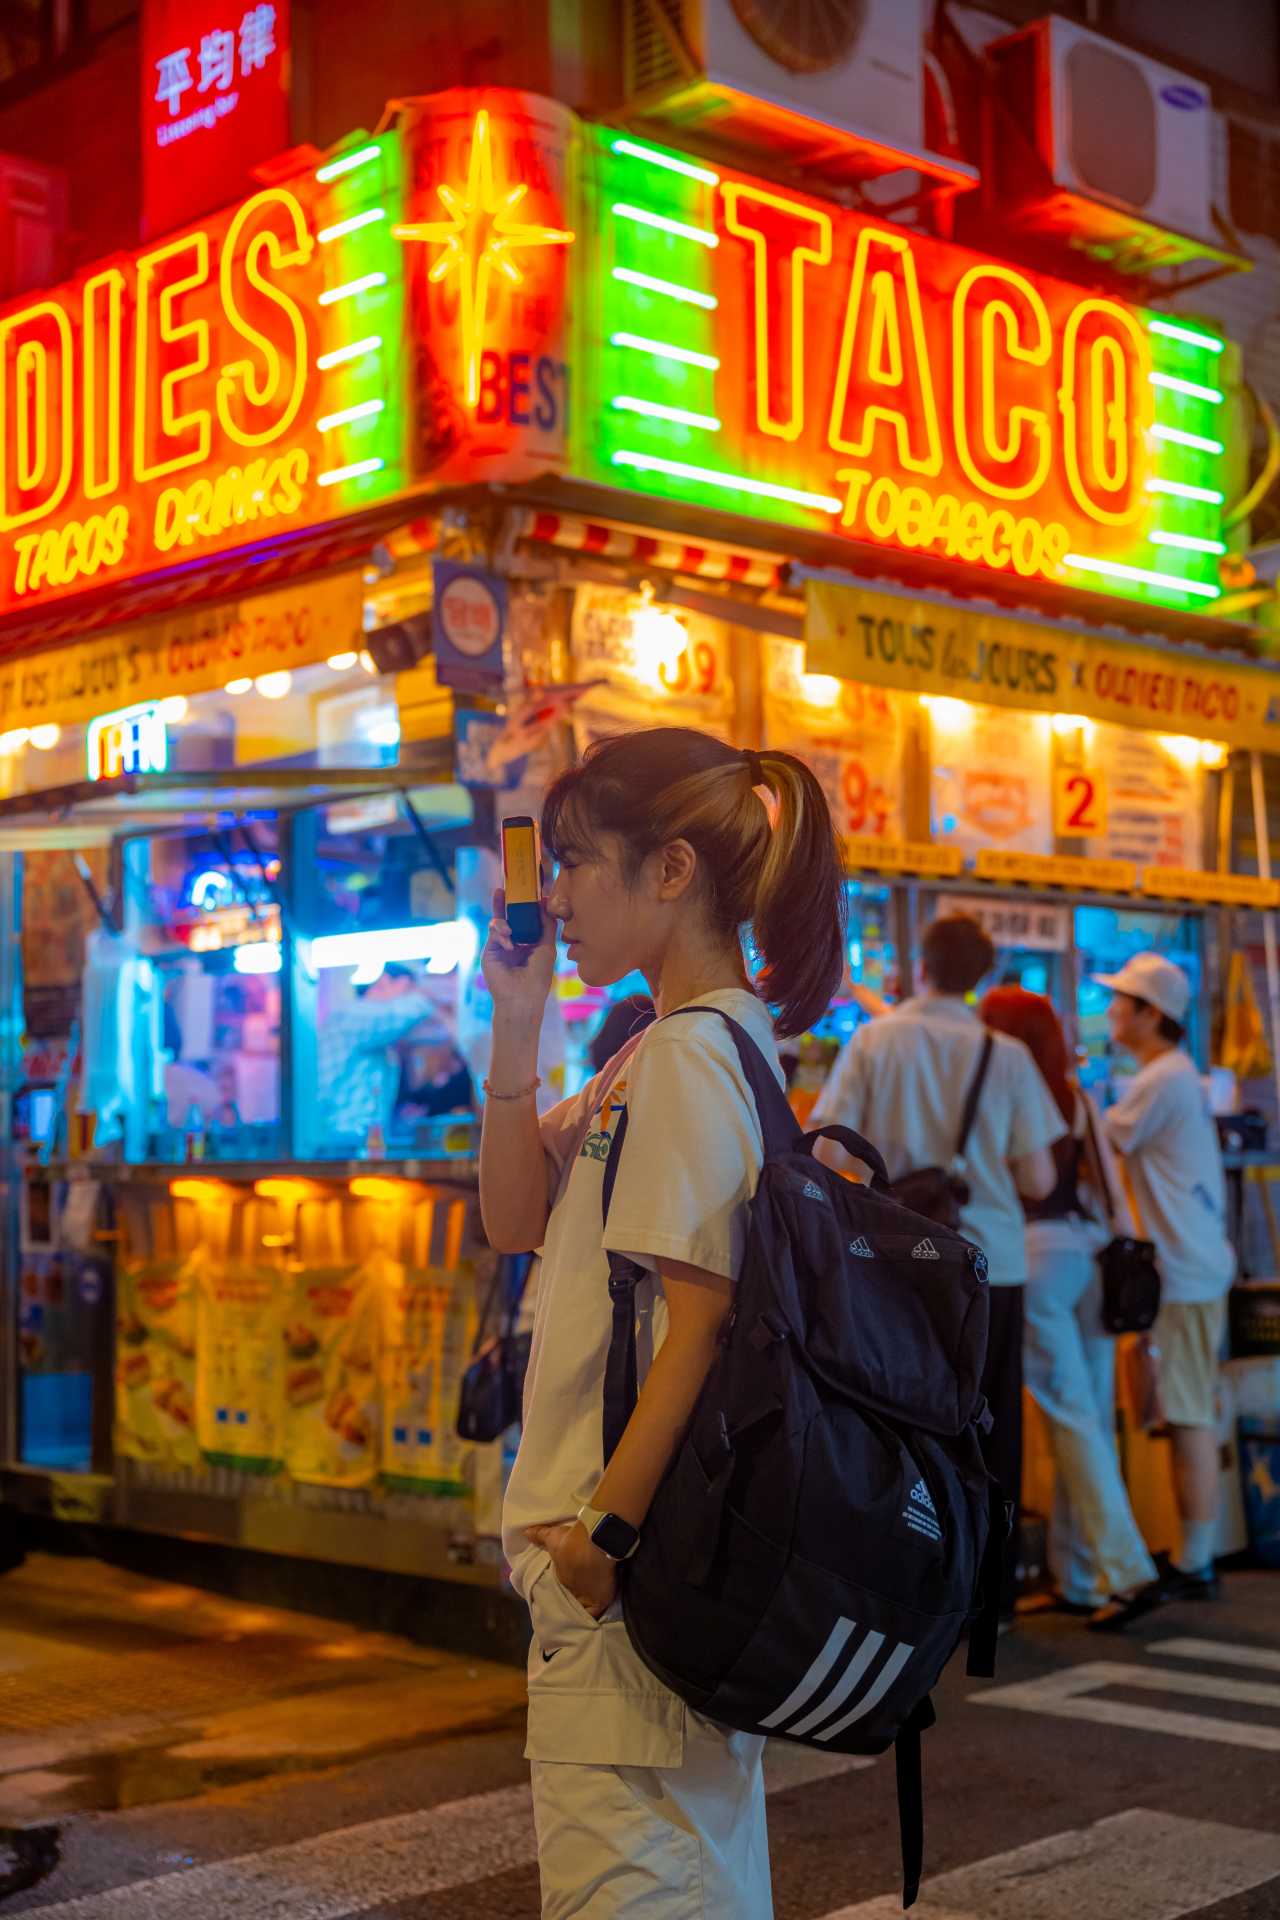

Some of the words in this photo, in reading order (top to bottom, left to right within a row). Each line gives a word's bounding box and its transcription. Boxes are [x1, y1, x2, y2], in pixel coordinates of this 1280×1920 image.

[720, 181, 1154, 526] TACO
[14, 505, 129, 594] TACOS
[154, 448, 309, 551] DRINKS
[1065, 776, 1096, 829] 2
